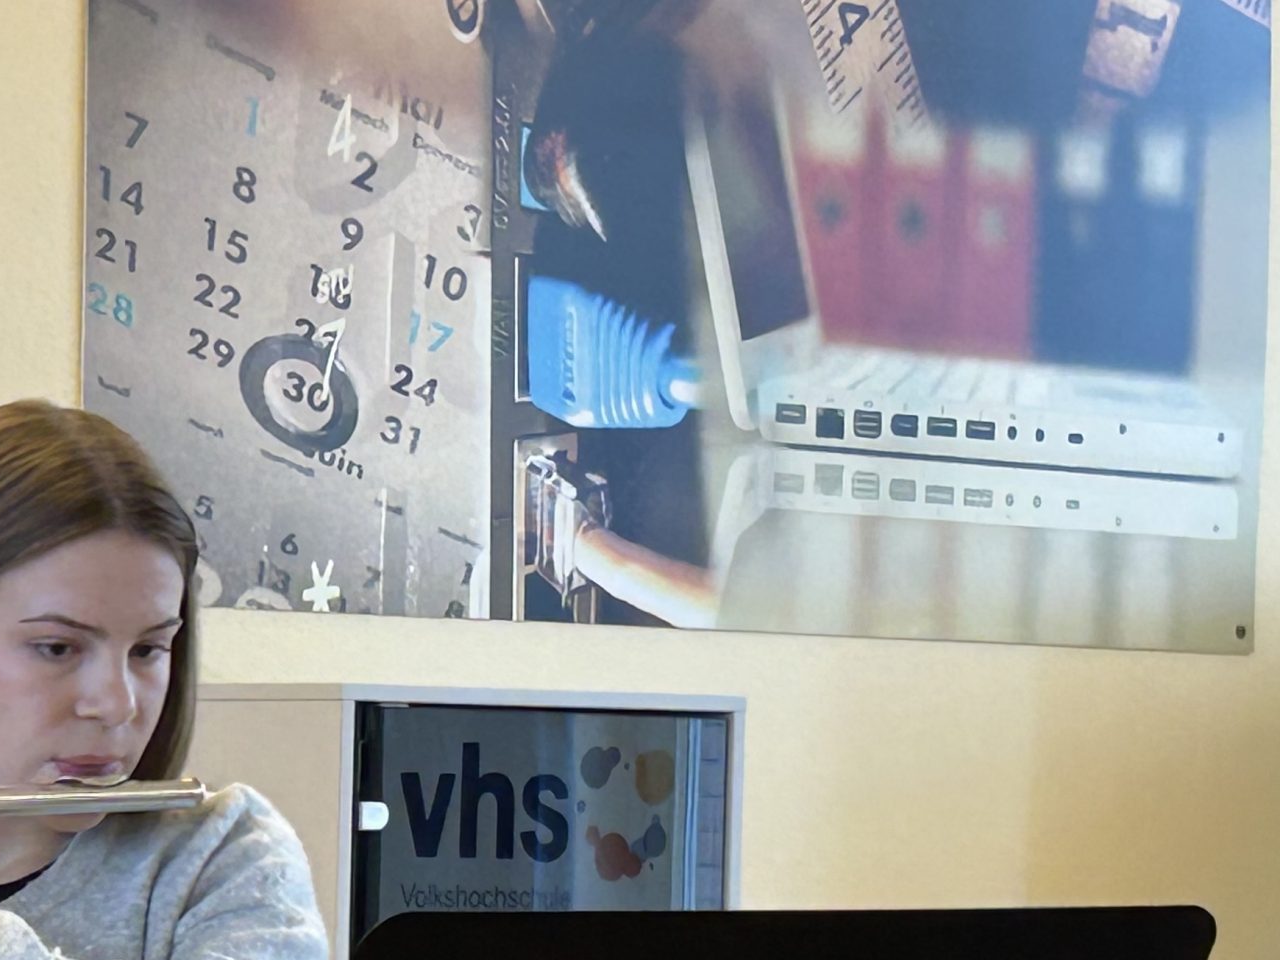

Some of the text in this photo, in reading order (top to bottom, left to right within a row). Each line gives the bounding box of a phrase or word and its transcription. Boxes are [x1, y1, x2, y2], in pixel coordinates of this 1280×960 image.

[124, 111, 468, 301] 7 8 9 10
[351, 151, 379, 192] 2
[94, 227, 137, 273] 21
[193, 273, 242, 320] 22
[390, 364, 438, 407] 24
[99, 164, 144, 216] 14
[204, 217, 249, 264] 15
[408, 309, 454, 353] 17
[87, 281, 421, 455] 28 29 30 31
[303, 446, 364, 480] uin
[280, 533, 299, 555] 6
[400, 742, 570, 864] vhs
